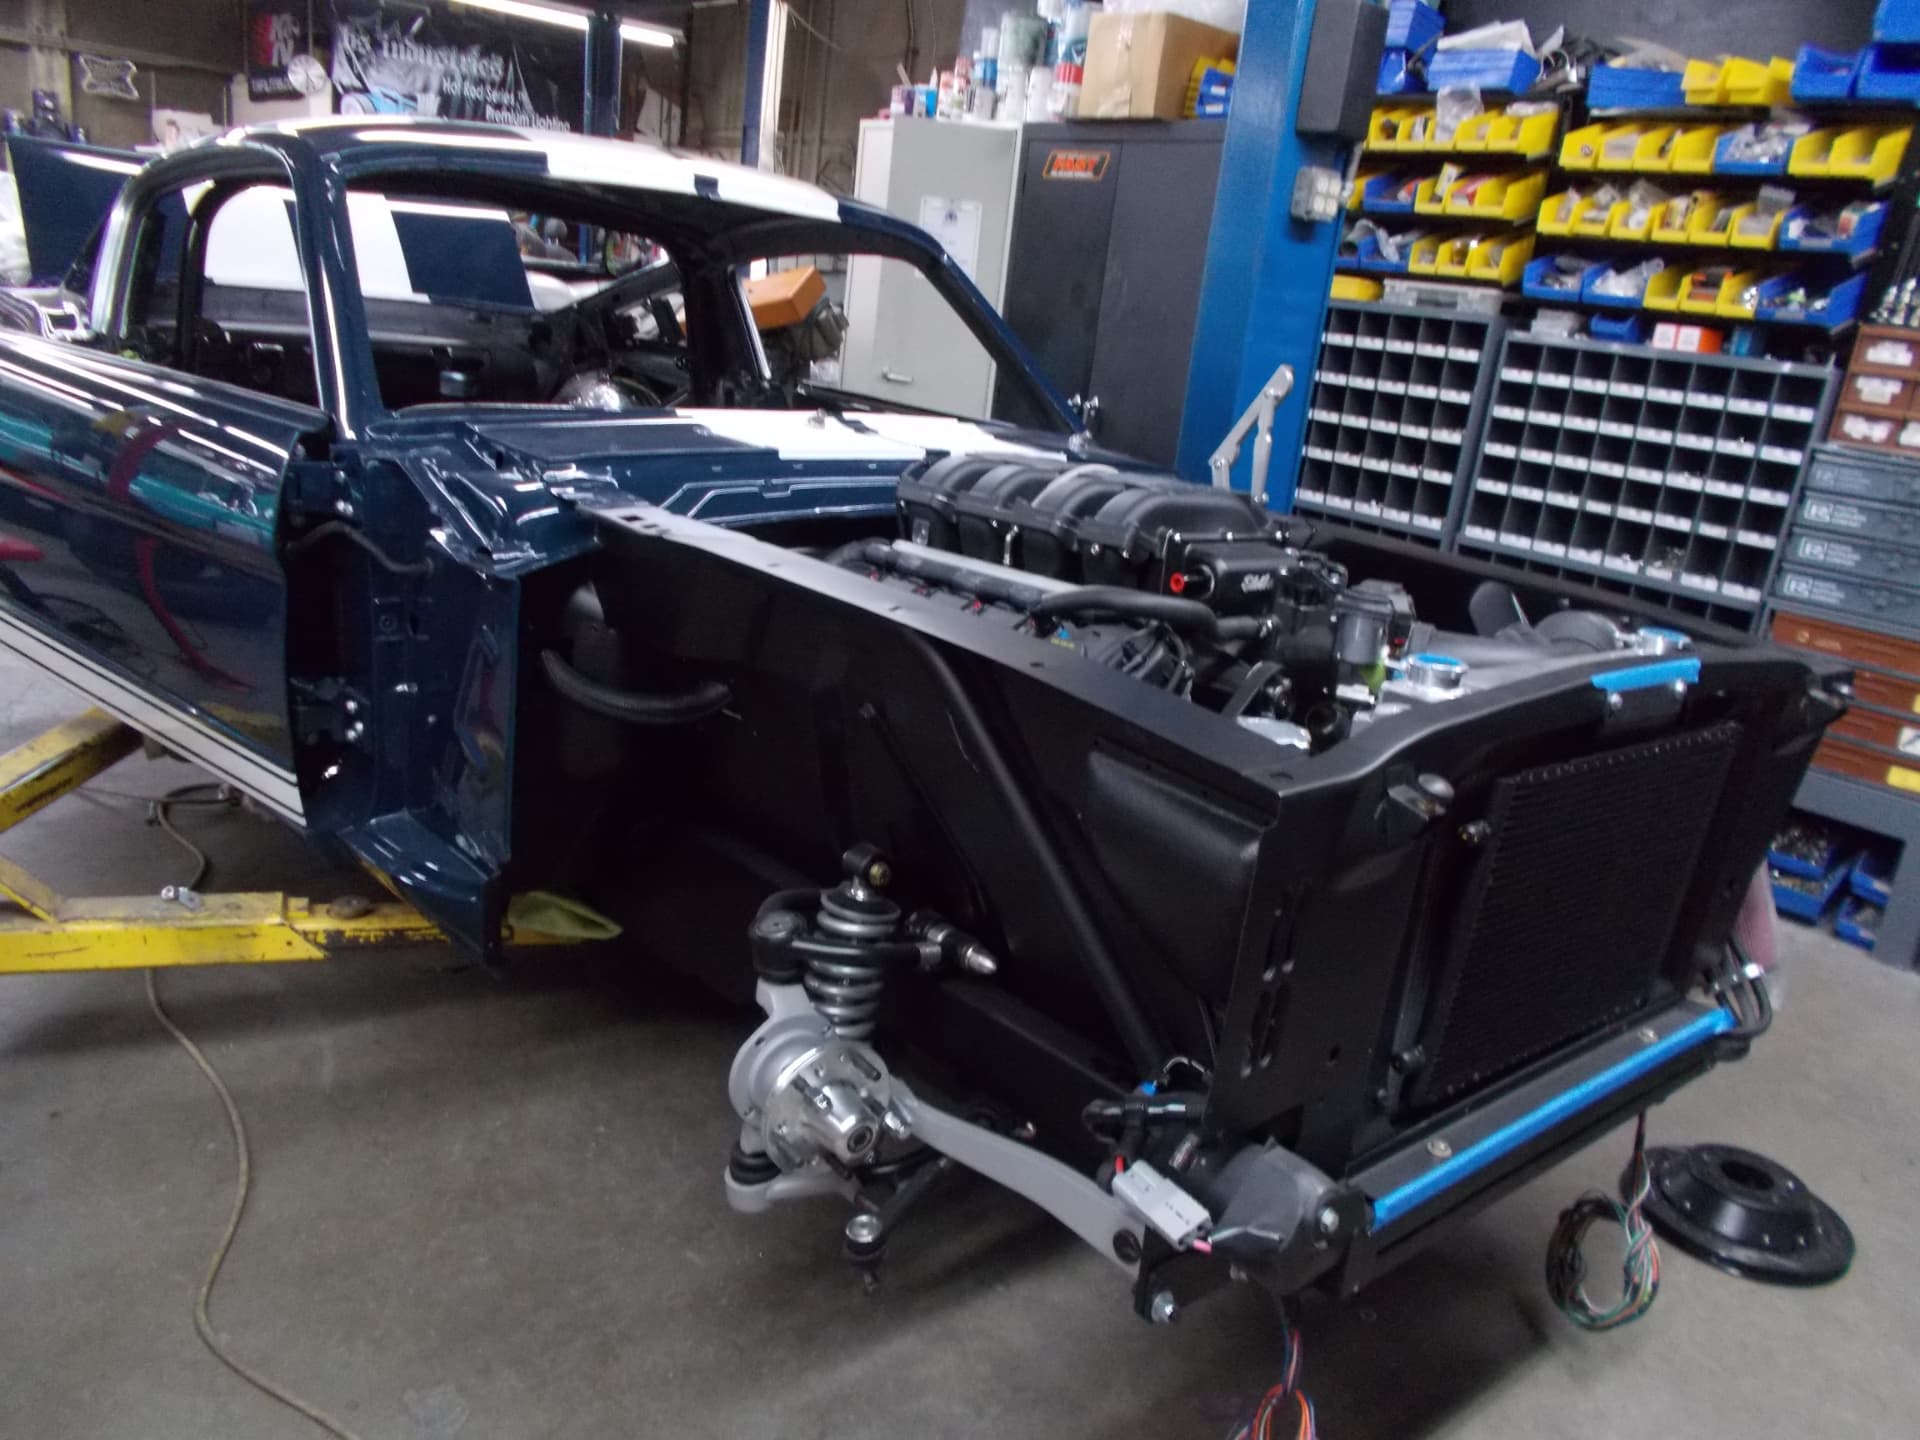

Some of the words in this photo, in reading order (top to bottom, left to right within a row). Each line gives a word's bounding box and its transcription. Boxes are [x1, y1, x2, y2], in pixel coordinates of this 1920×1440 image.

[442, 77, 461, 97] Hot
[464, 80, 484, 101] Rod
[486, 85, 516, 105] Series
[486, 104, 530, 128] Premium
